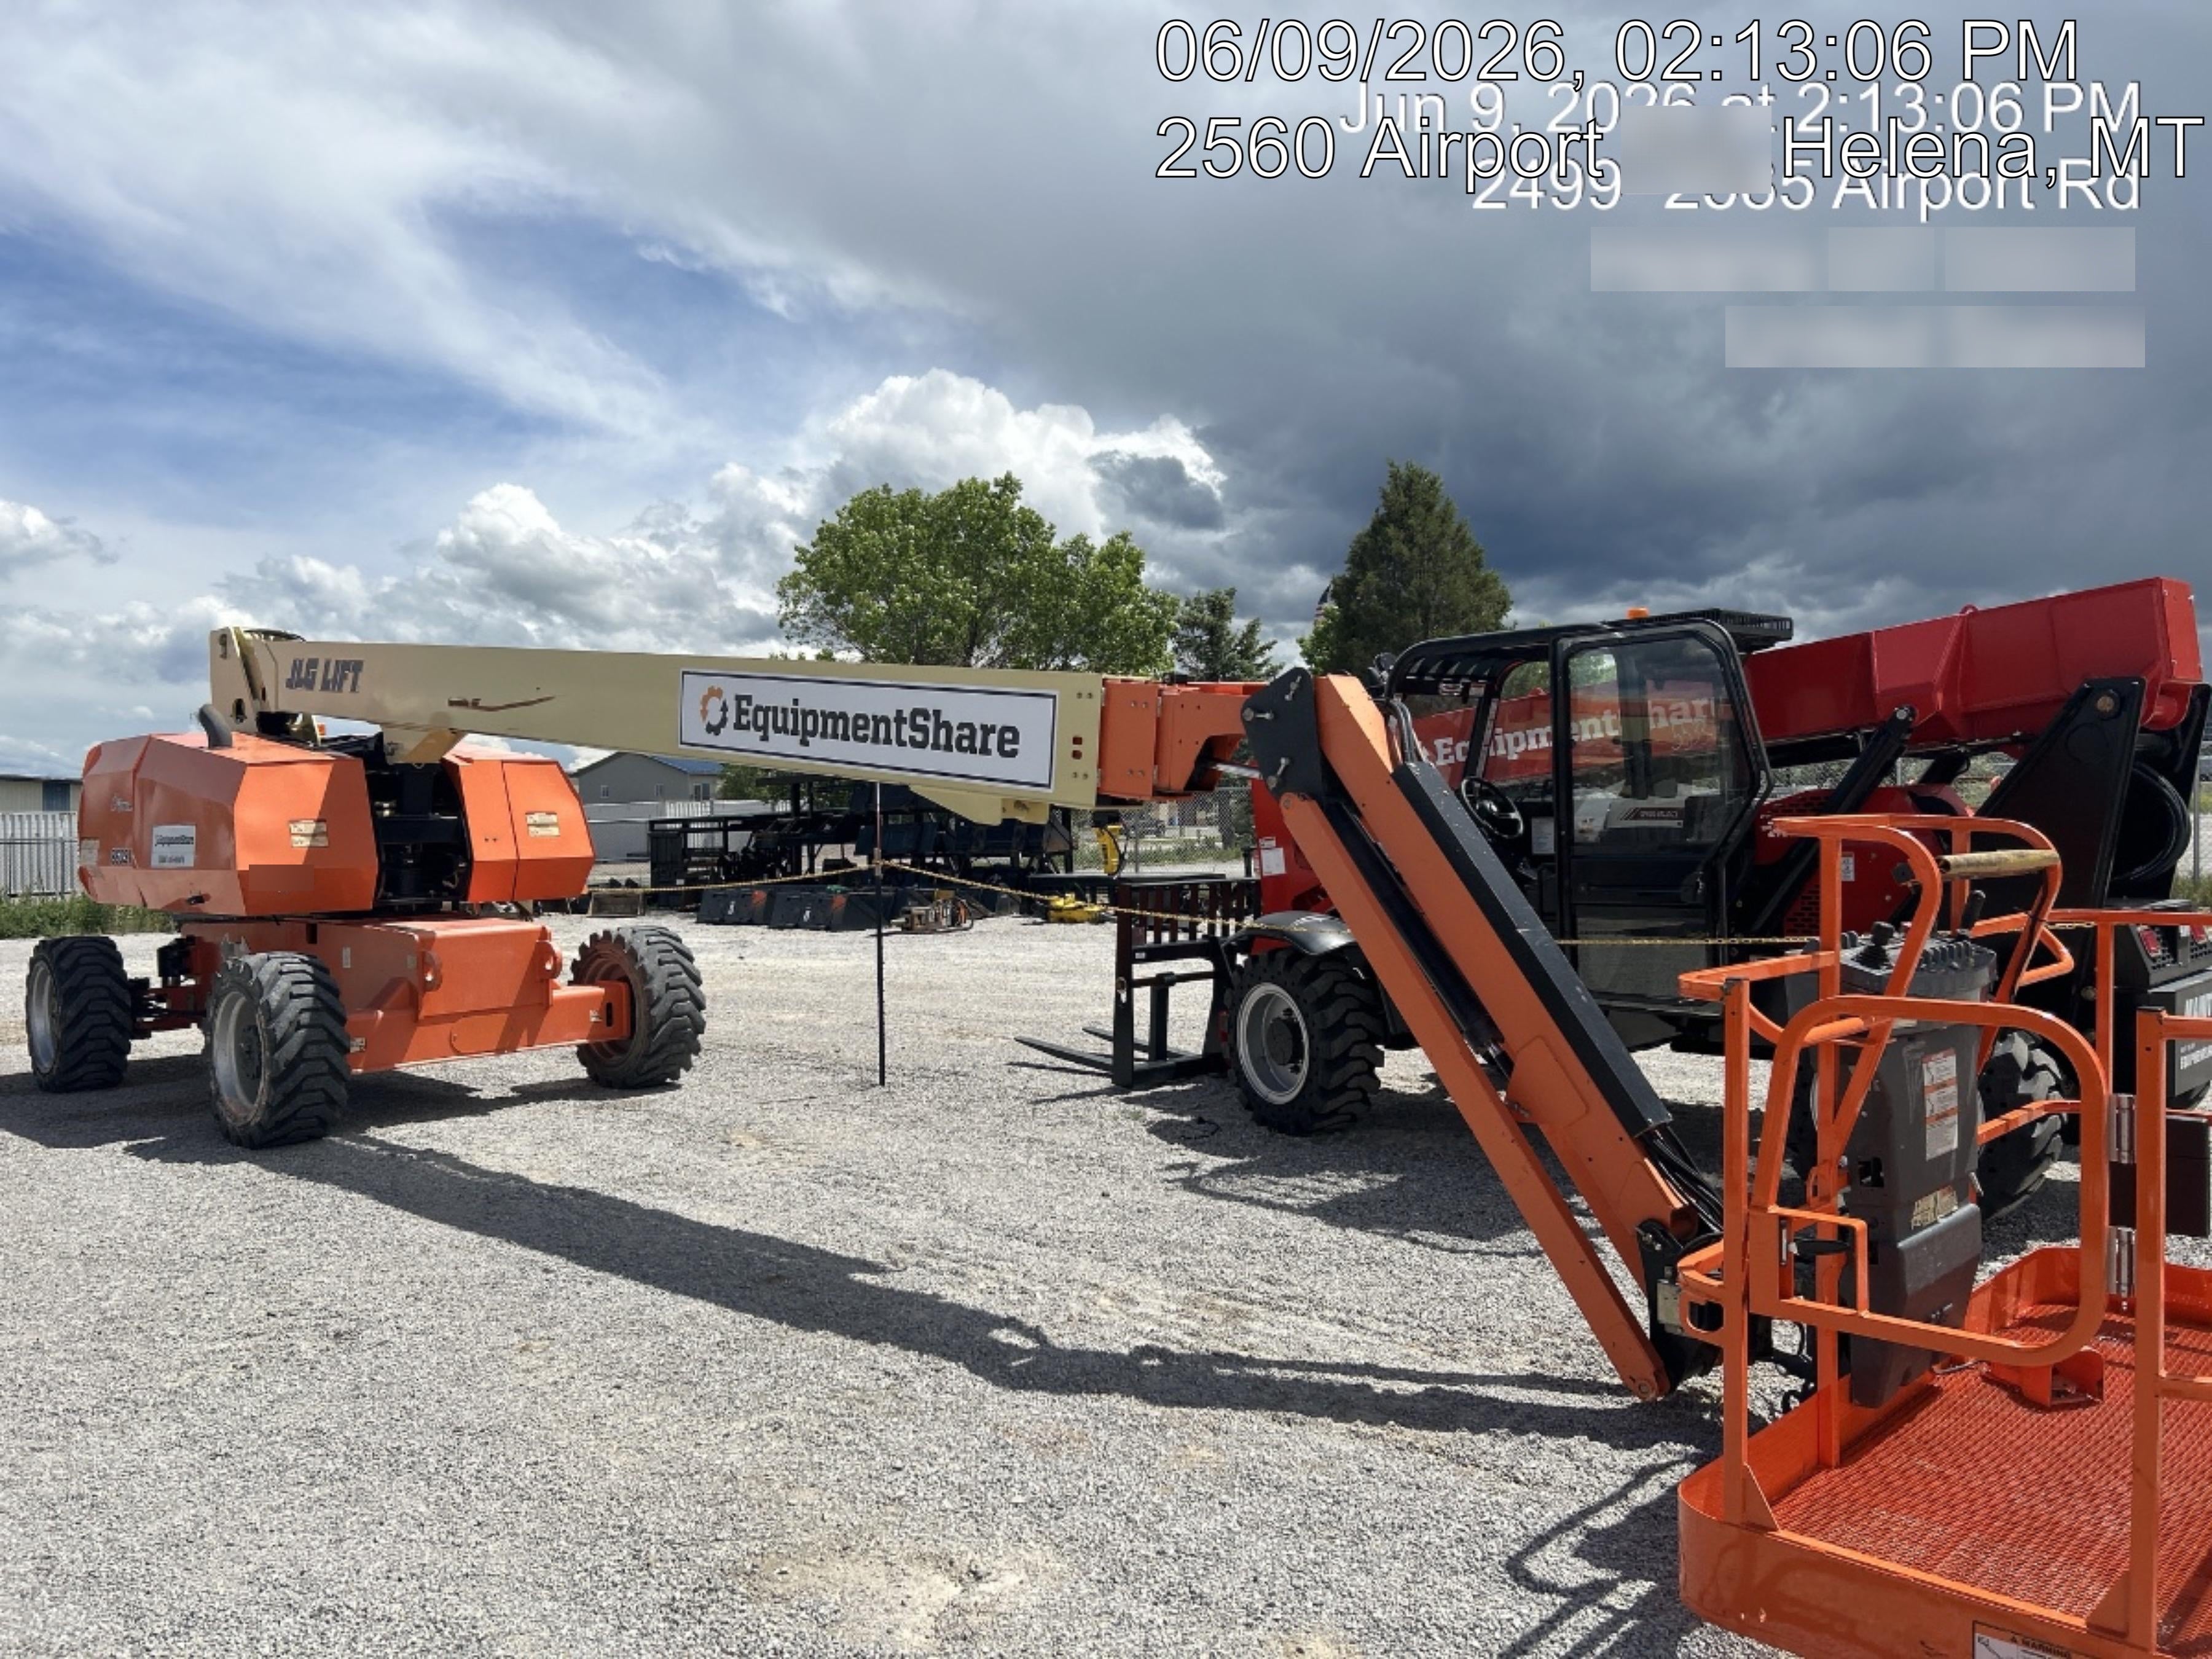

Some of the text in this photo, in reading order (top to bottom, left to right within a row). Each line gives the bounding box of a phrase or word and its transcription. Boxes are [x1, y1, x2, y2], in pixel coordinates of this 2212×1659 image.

[285, 657, 366, 694] JLG LIFT
[733, 694, 1020, 758] EquipmentShare
